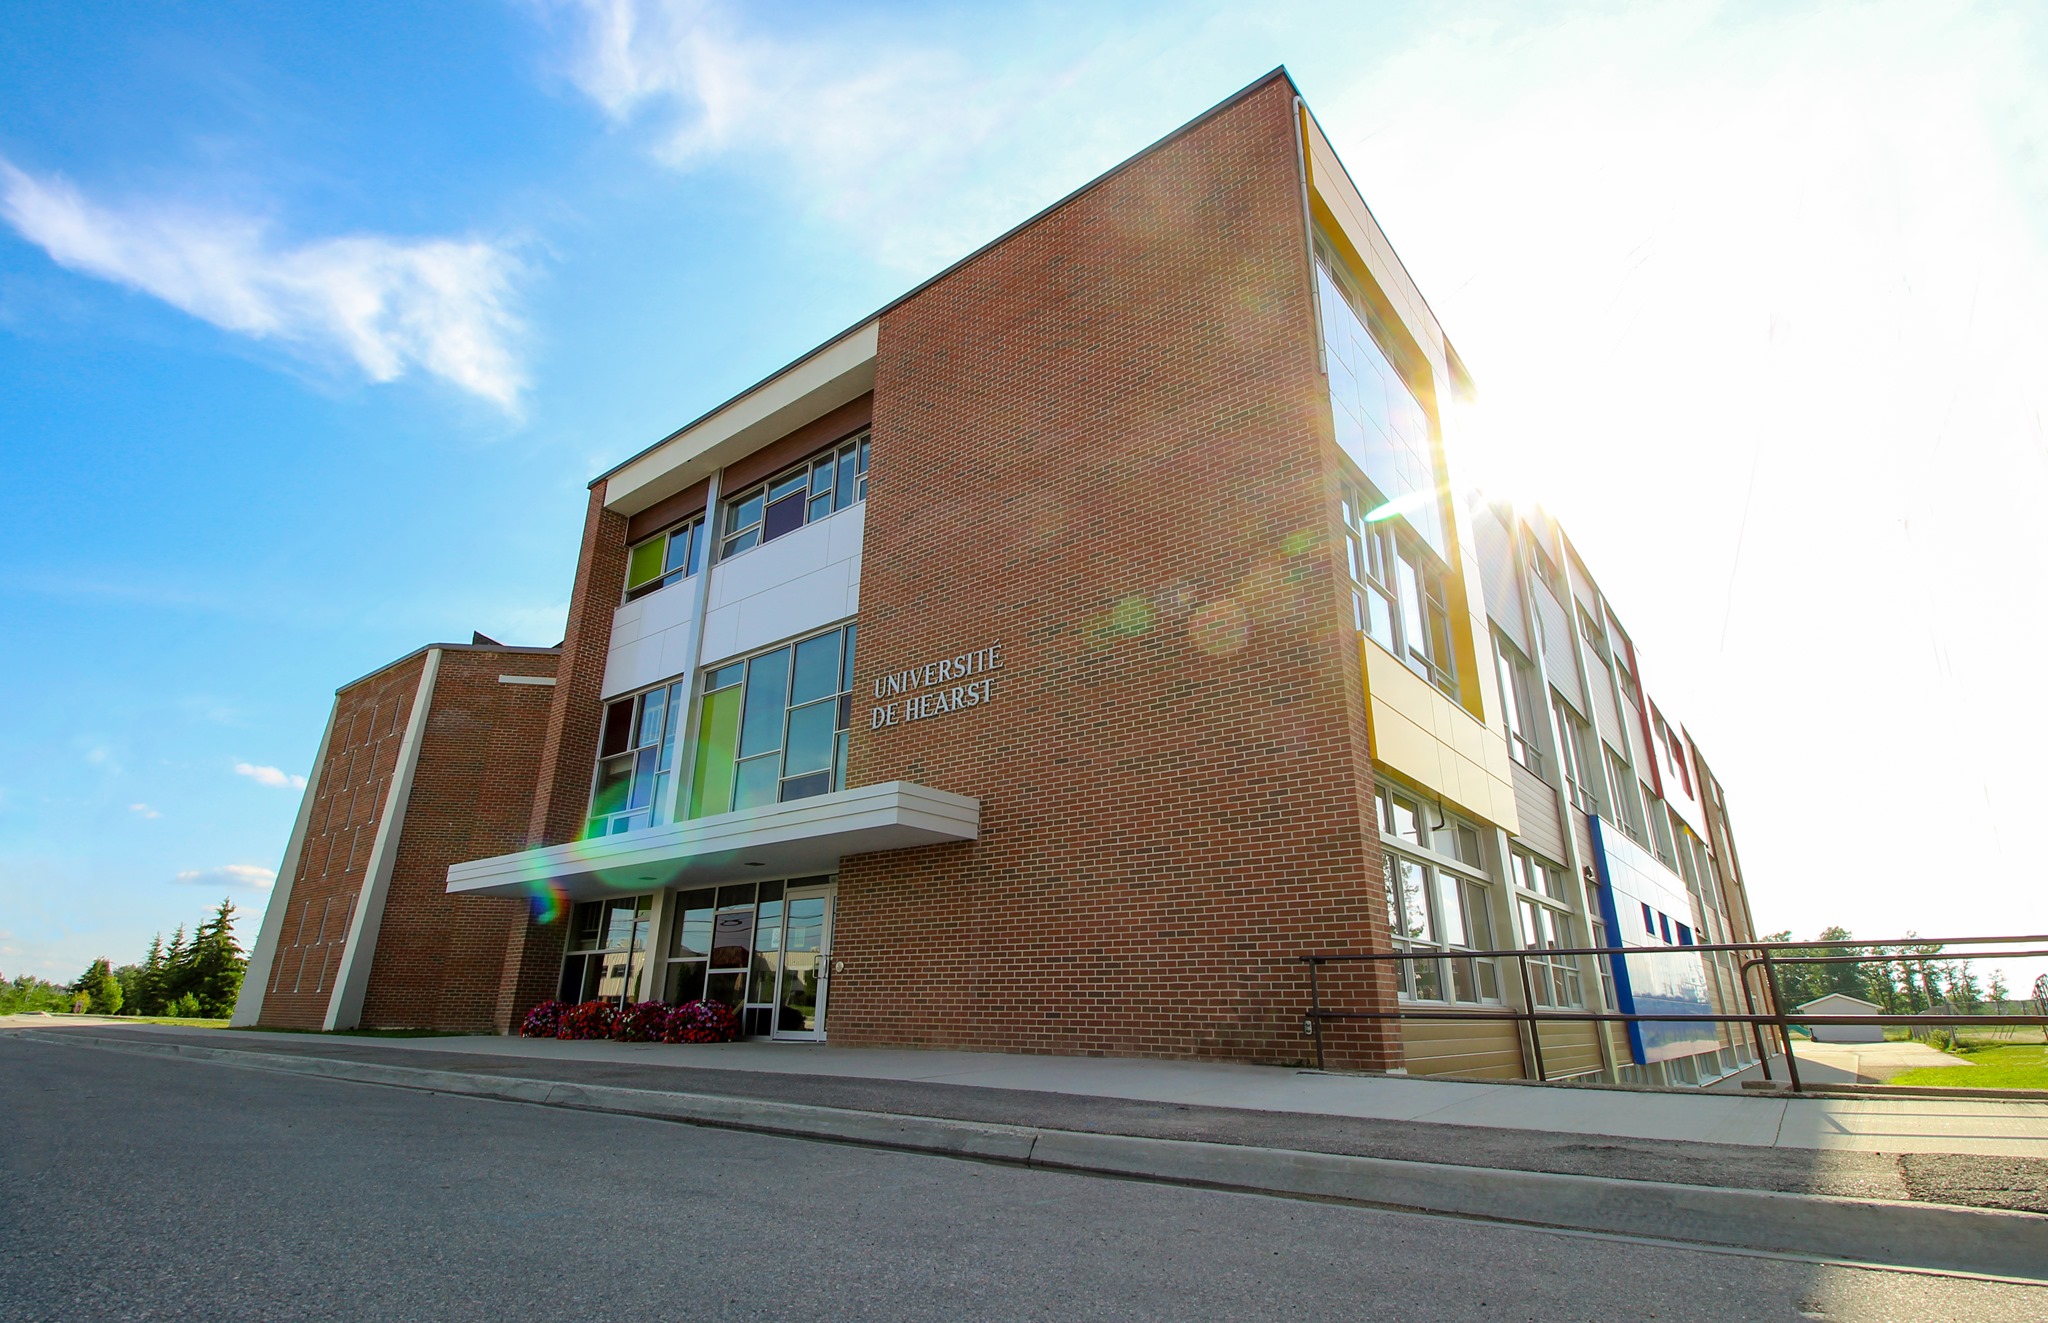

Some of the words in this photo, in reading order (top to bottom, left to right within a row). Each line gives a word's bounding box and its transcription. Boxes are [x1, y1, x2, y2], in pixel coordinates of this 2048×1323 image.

[874, 638, 1004, 699] UNIVERSITÉ
[872, 702, 899, 730] DE
[905, 678, 995, 722] HEARST
